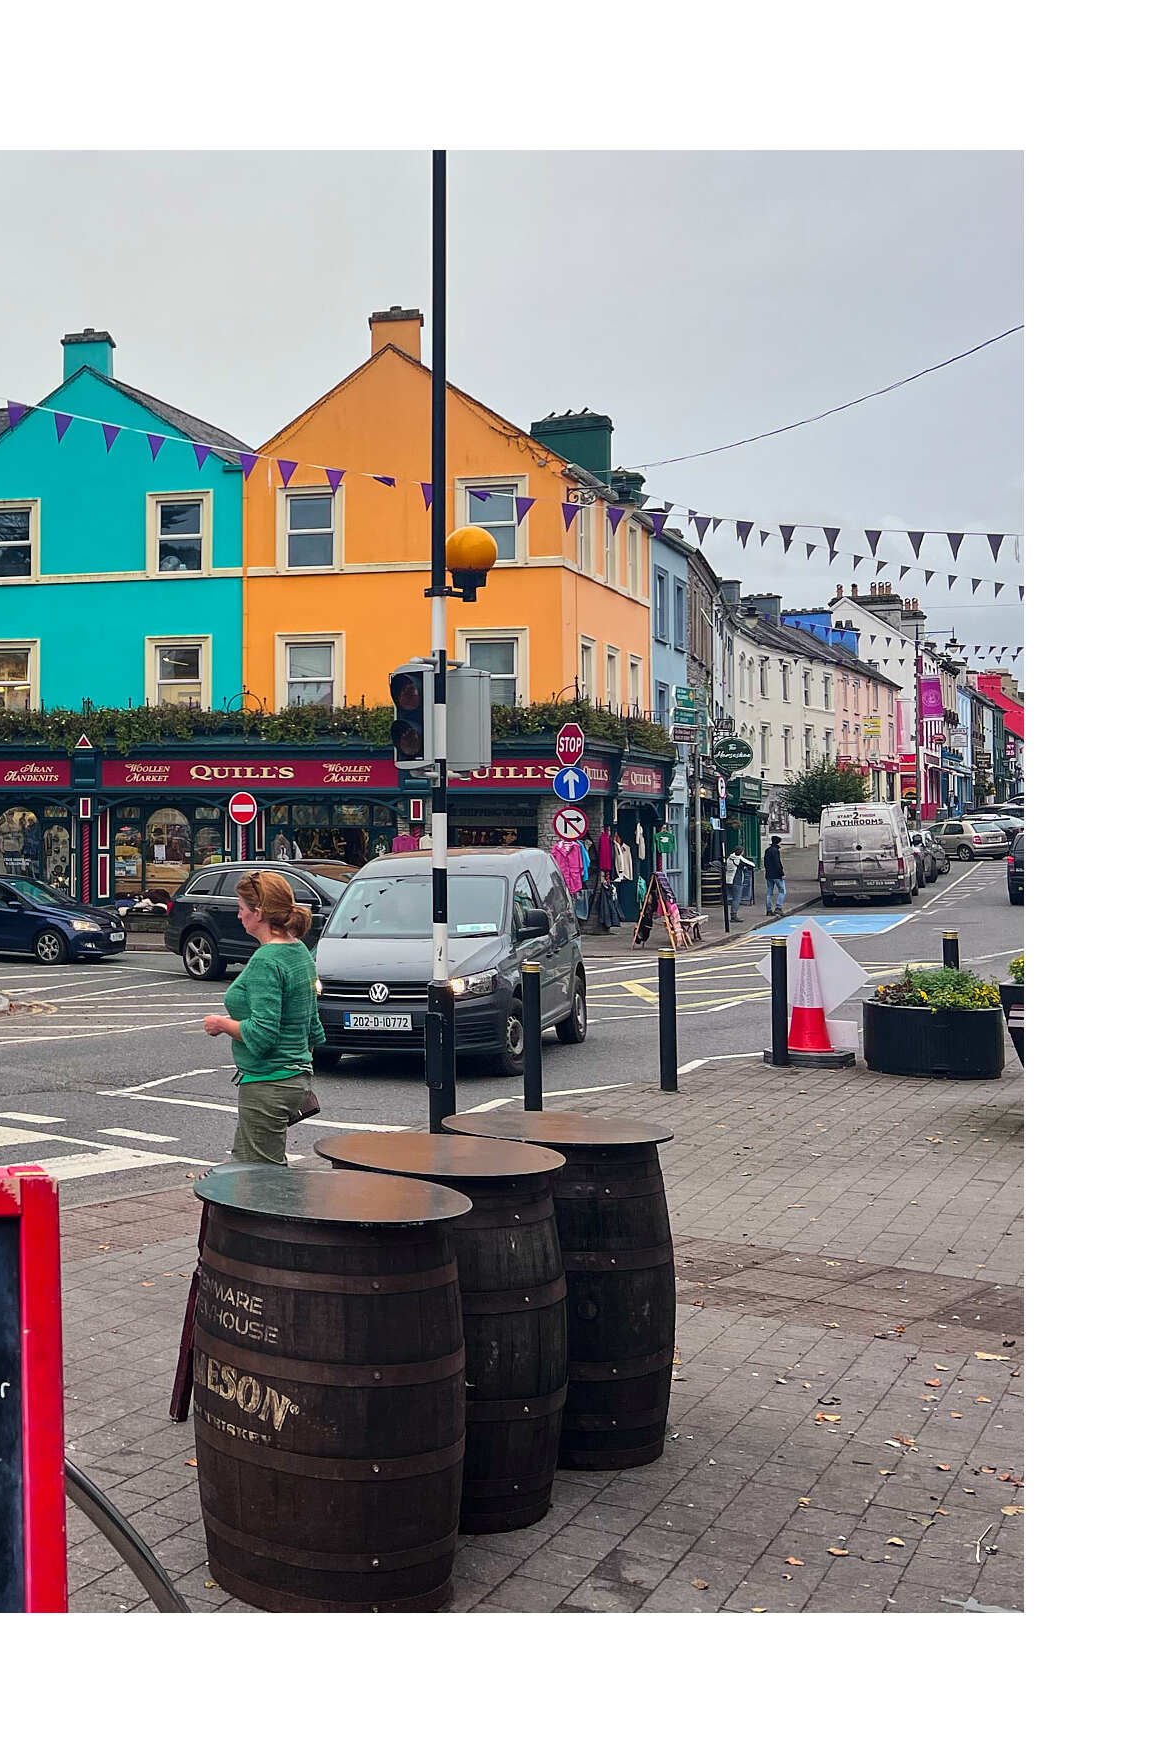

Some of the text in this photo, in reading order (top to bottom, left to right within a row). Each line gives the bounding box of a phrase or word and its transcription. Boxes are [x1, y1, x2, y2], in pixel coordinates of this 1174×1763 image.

[558, 737, 582, 753] STOP
[20, 763, 54, 773] ARAN
[124, 762, 171, 773] WOOLLEN
[189, 765, 296, 780] QUILL'S
[322, 762, 372, 773] WOOLLEN
[4, 770, 59, 782] HANDKNITS
[125, 772, 170, 783] MARKET
[323, 772, 371, 783] MARKET
[459, 766, 561, 781] UILL'S
[852, 811, 860, 820] 2
[830, 819, 884, 827] BATHROOMS
[353, 1016, 408, 1028] 202-D-10772
